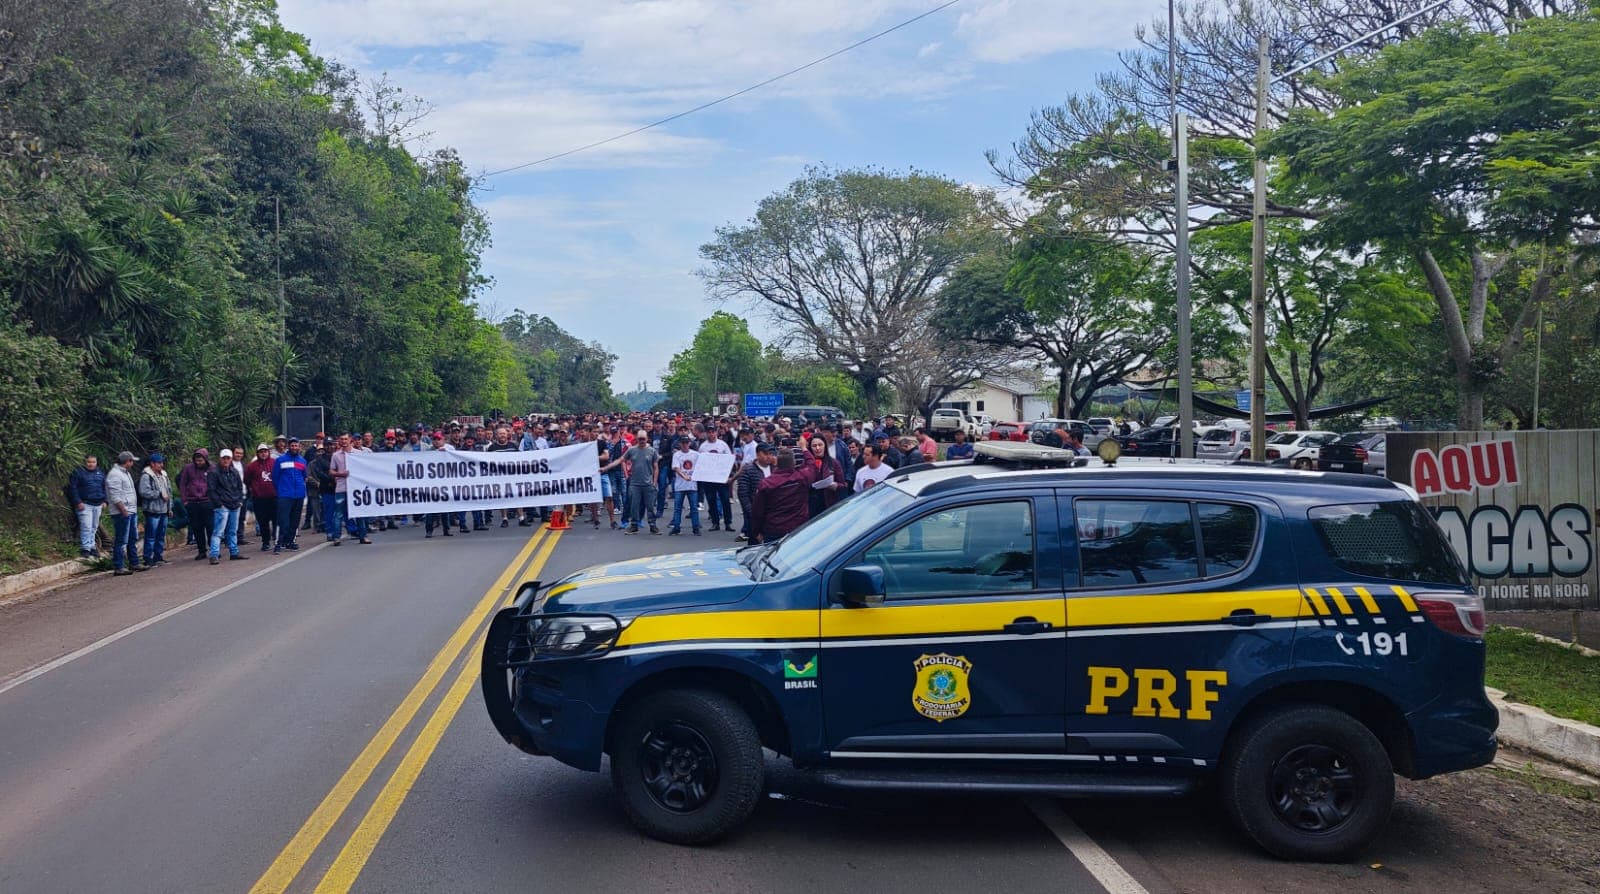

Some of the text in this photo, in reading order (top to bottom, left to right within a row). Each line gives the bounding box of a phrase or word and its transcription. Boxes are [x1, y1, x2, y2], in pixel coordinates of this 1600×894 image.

[397, 458, 552, 481] NÃO SOMOS BANDIDOS,
[1412, 439, 1520, 496] AQUI
[353, 476, 597, 507] SÓ QUEREMOS VOLTAR A TRABALHAR.
[1491, 585, 1529, 599] NOME
[1534, 584, 1551, 599] NA
[1555, 583, 1589, 598] HORA
[1357, 632, 1408, 656] 191
[784, 680, 818, 690] BRASIL
[1085, 666, 1228, 721] PRF
[925, 709, 956, 717] FEDERAL
